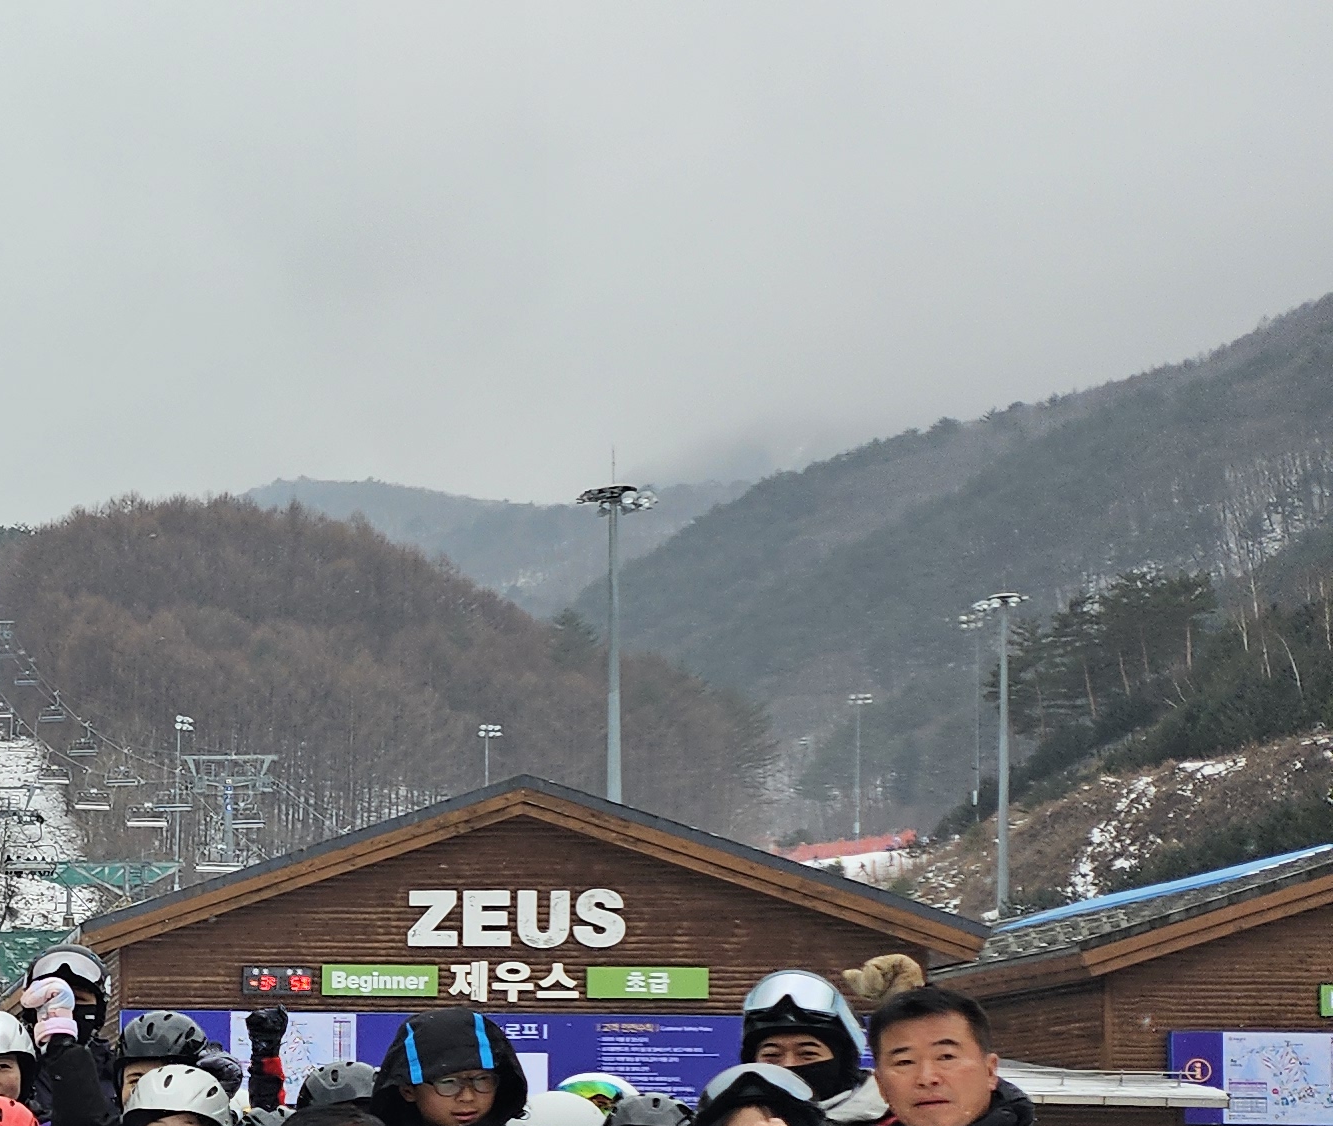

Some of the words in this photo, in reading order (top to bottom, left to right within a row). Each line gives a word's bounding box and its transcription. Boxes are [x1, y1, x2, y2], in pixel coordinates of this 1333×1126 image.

[407, 889, 626, 949] ZEUS
[331, 970, 429, 993] Beginner
[447, 960, 580, 1003] 제우스
[624, 971, 671, 994] 초급
[500, 1023, 540, 1040] 로프
